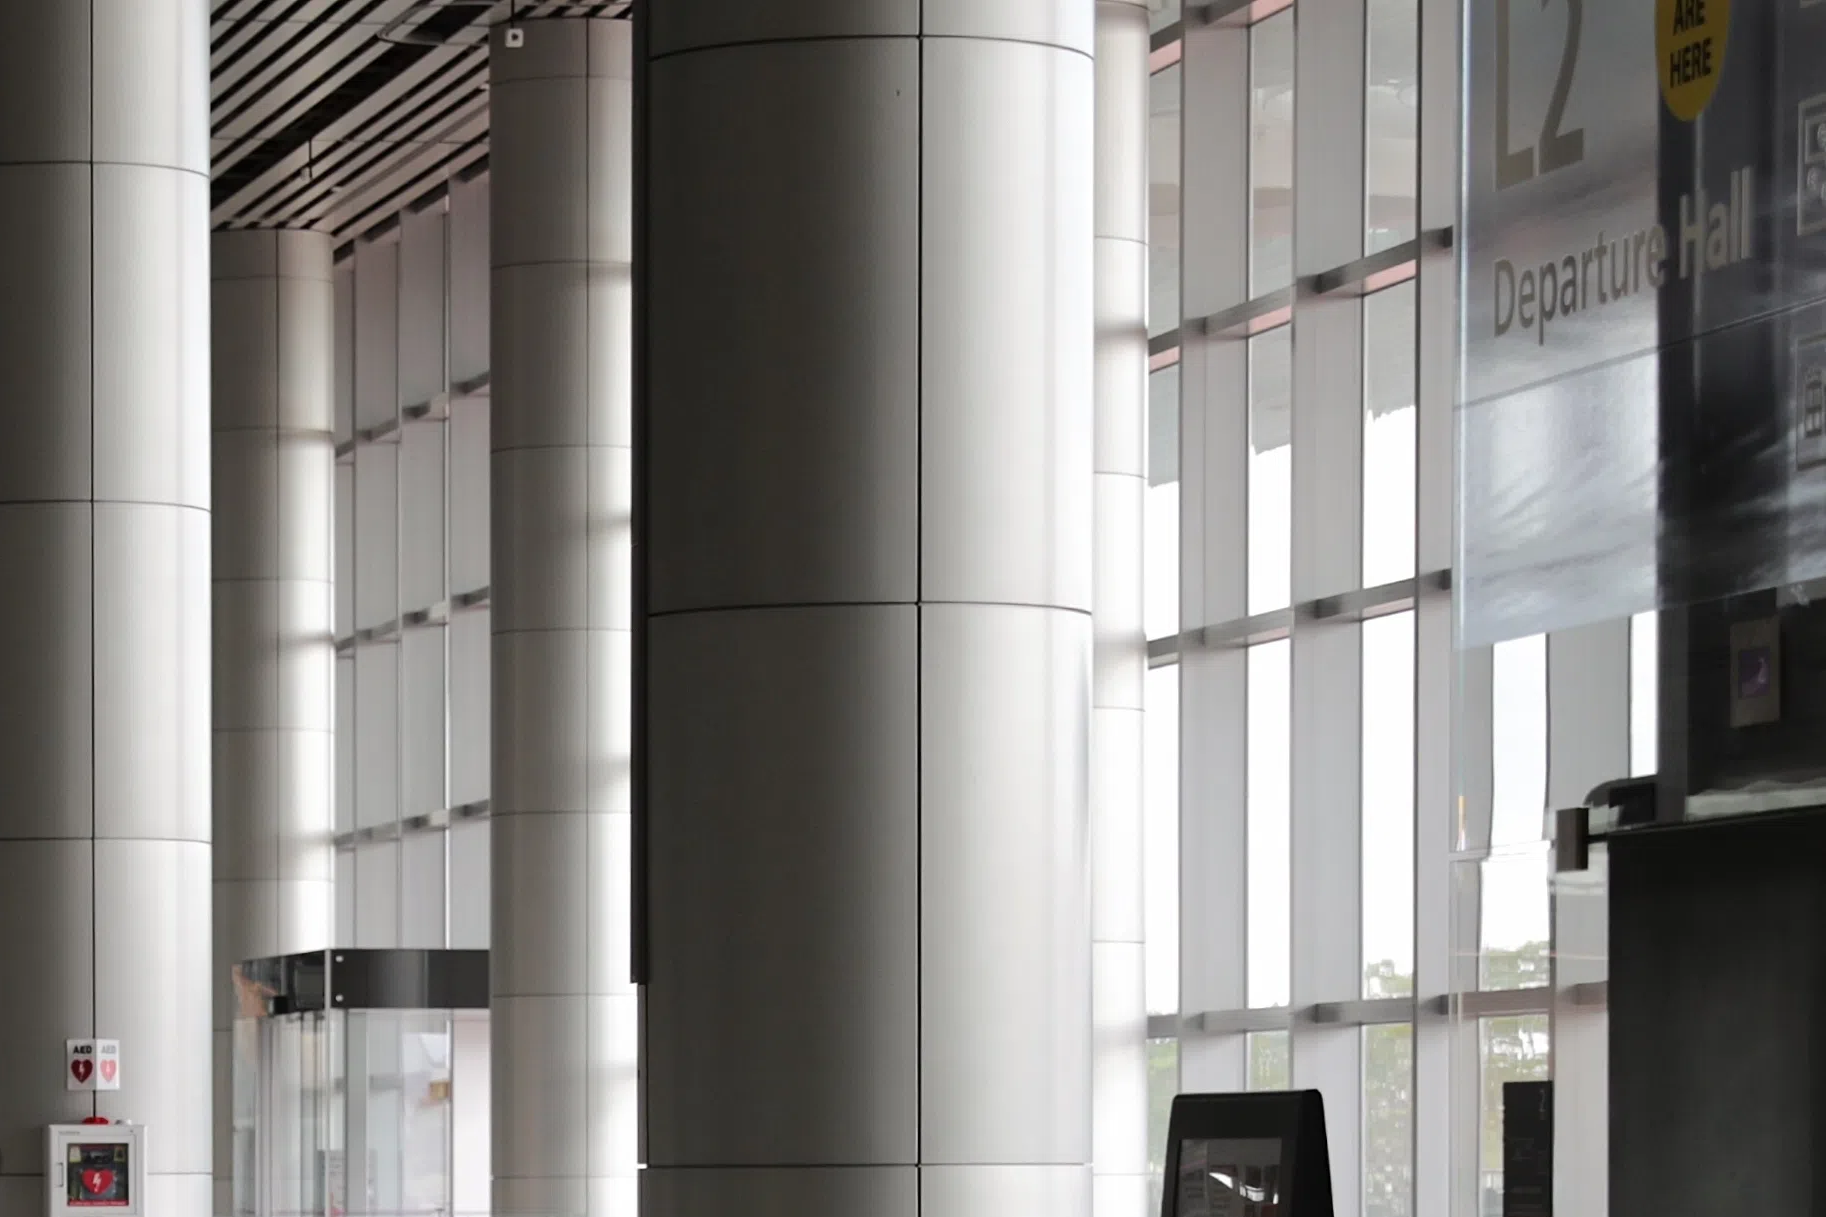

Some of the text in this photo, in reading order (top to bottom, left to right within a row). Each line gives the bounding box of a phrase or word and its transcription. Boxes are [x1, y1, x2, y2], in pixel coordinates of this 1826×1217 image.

[1673, 0, 1706, 35] ARE
[1669, 37, 1713, 90] HERE
[1493, 0, 1585, 192] L2
[1492, 165, 1753, 346] Departure Hall
[73, 1045, 92, 1055] AED
[101, 1045, 117, 1055] AED
